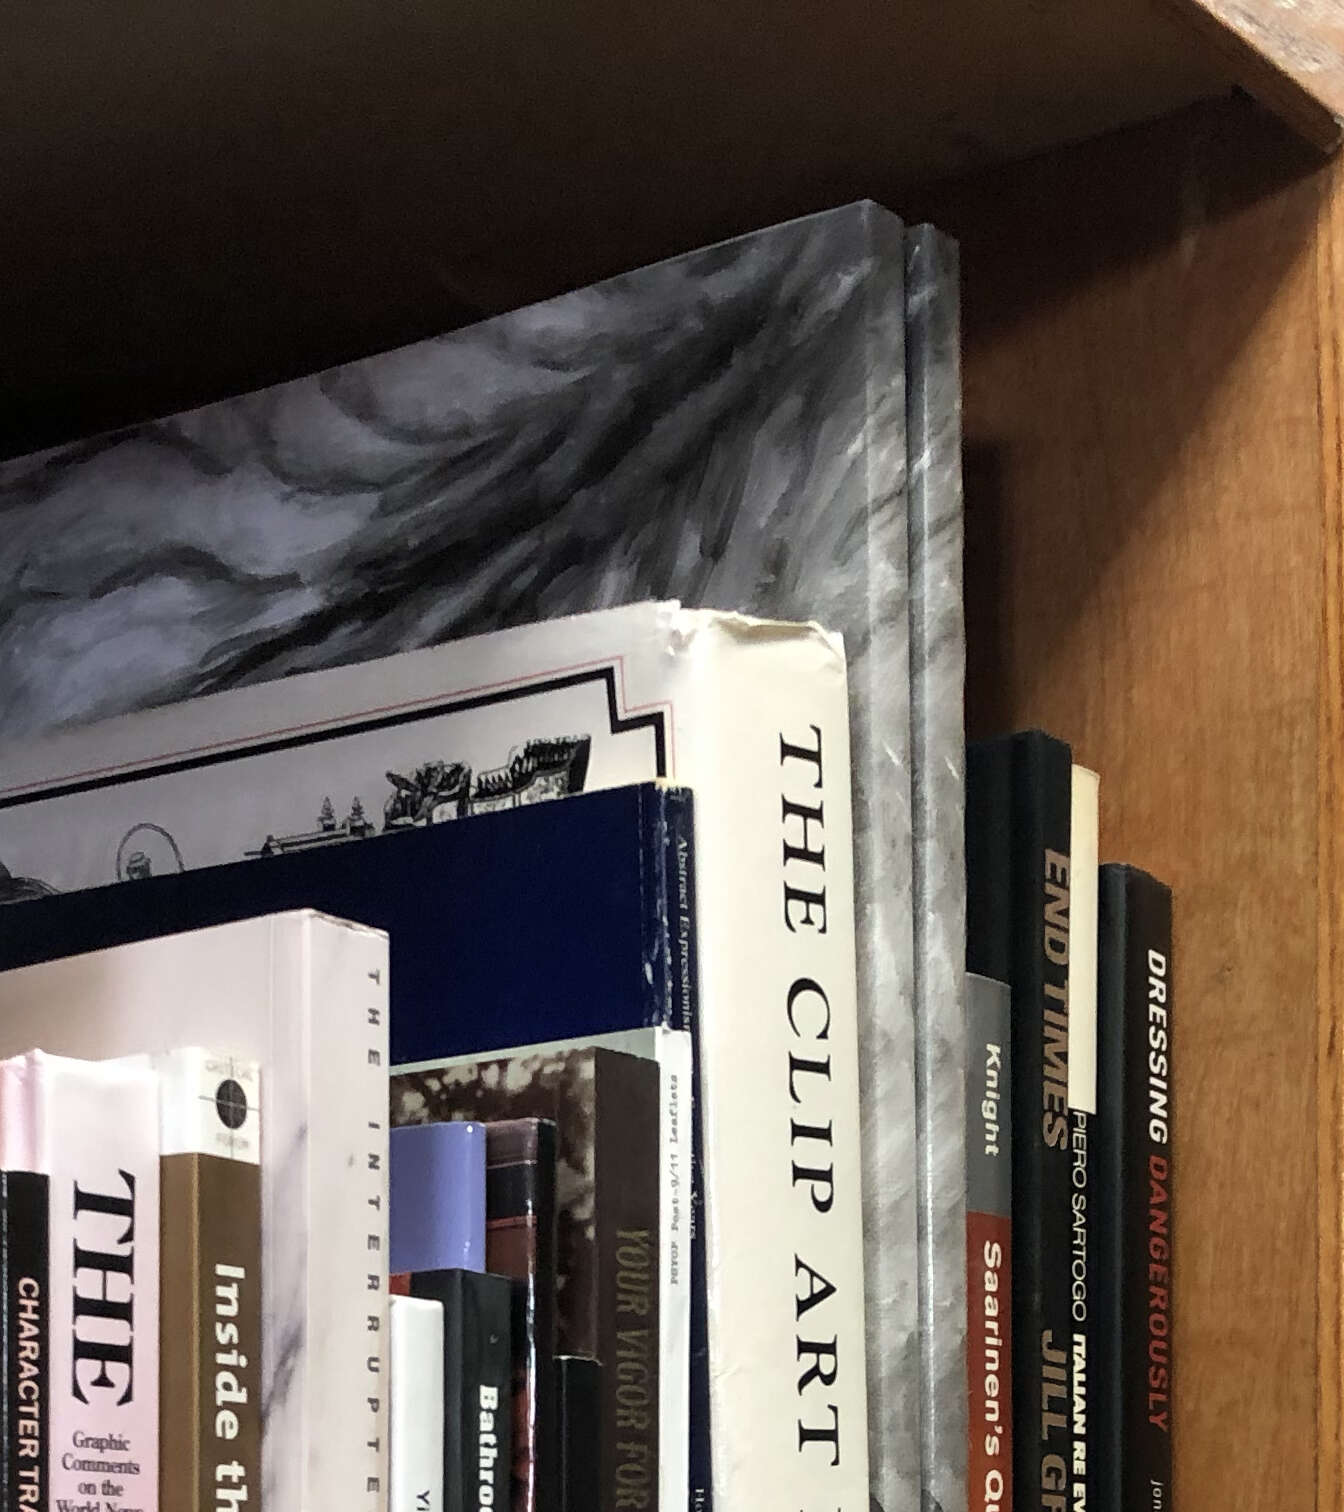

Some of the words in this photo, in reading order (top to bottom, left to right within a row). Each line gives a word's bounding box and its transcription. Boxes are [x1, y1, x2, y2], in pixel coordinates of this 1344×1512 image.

[778, 724, 828, 938] THE
[1040, 848, 1072, 962] END
[366, 968, 382, 1067] THE
[1040, 979, 1070, 1151] TIMES
[1146, 949, 1169, 1148] DRESSING
[784, 975, 835, 1216] CLIP
[979, 1041, 1004, 1157] Knight
[1071, 1109, 1089, 1188] PIERO
[71, 1168, 136, 1409] THE
[1071, 1191, 1089, 1321] SARTOGO
[1146, 1153, 1169, 1433] DANGEROUSLY
[16, 1275, 41, 1458] CHARACTER
[213, 1263, 248, 1442] Inside
[793, 1253, 842, 1469] ART
[1038, 1329, 1068, 1441] JILL
[1072, 1332, 1089, 1437] ITALIAN
[61, 1452, 141, 1476] Comments
[71, 1429, 132, 1452] Graphic
[77, 1482, 105, 1495] on
